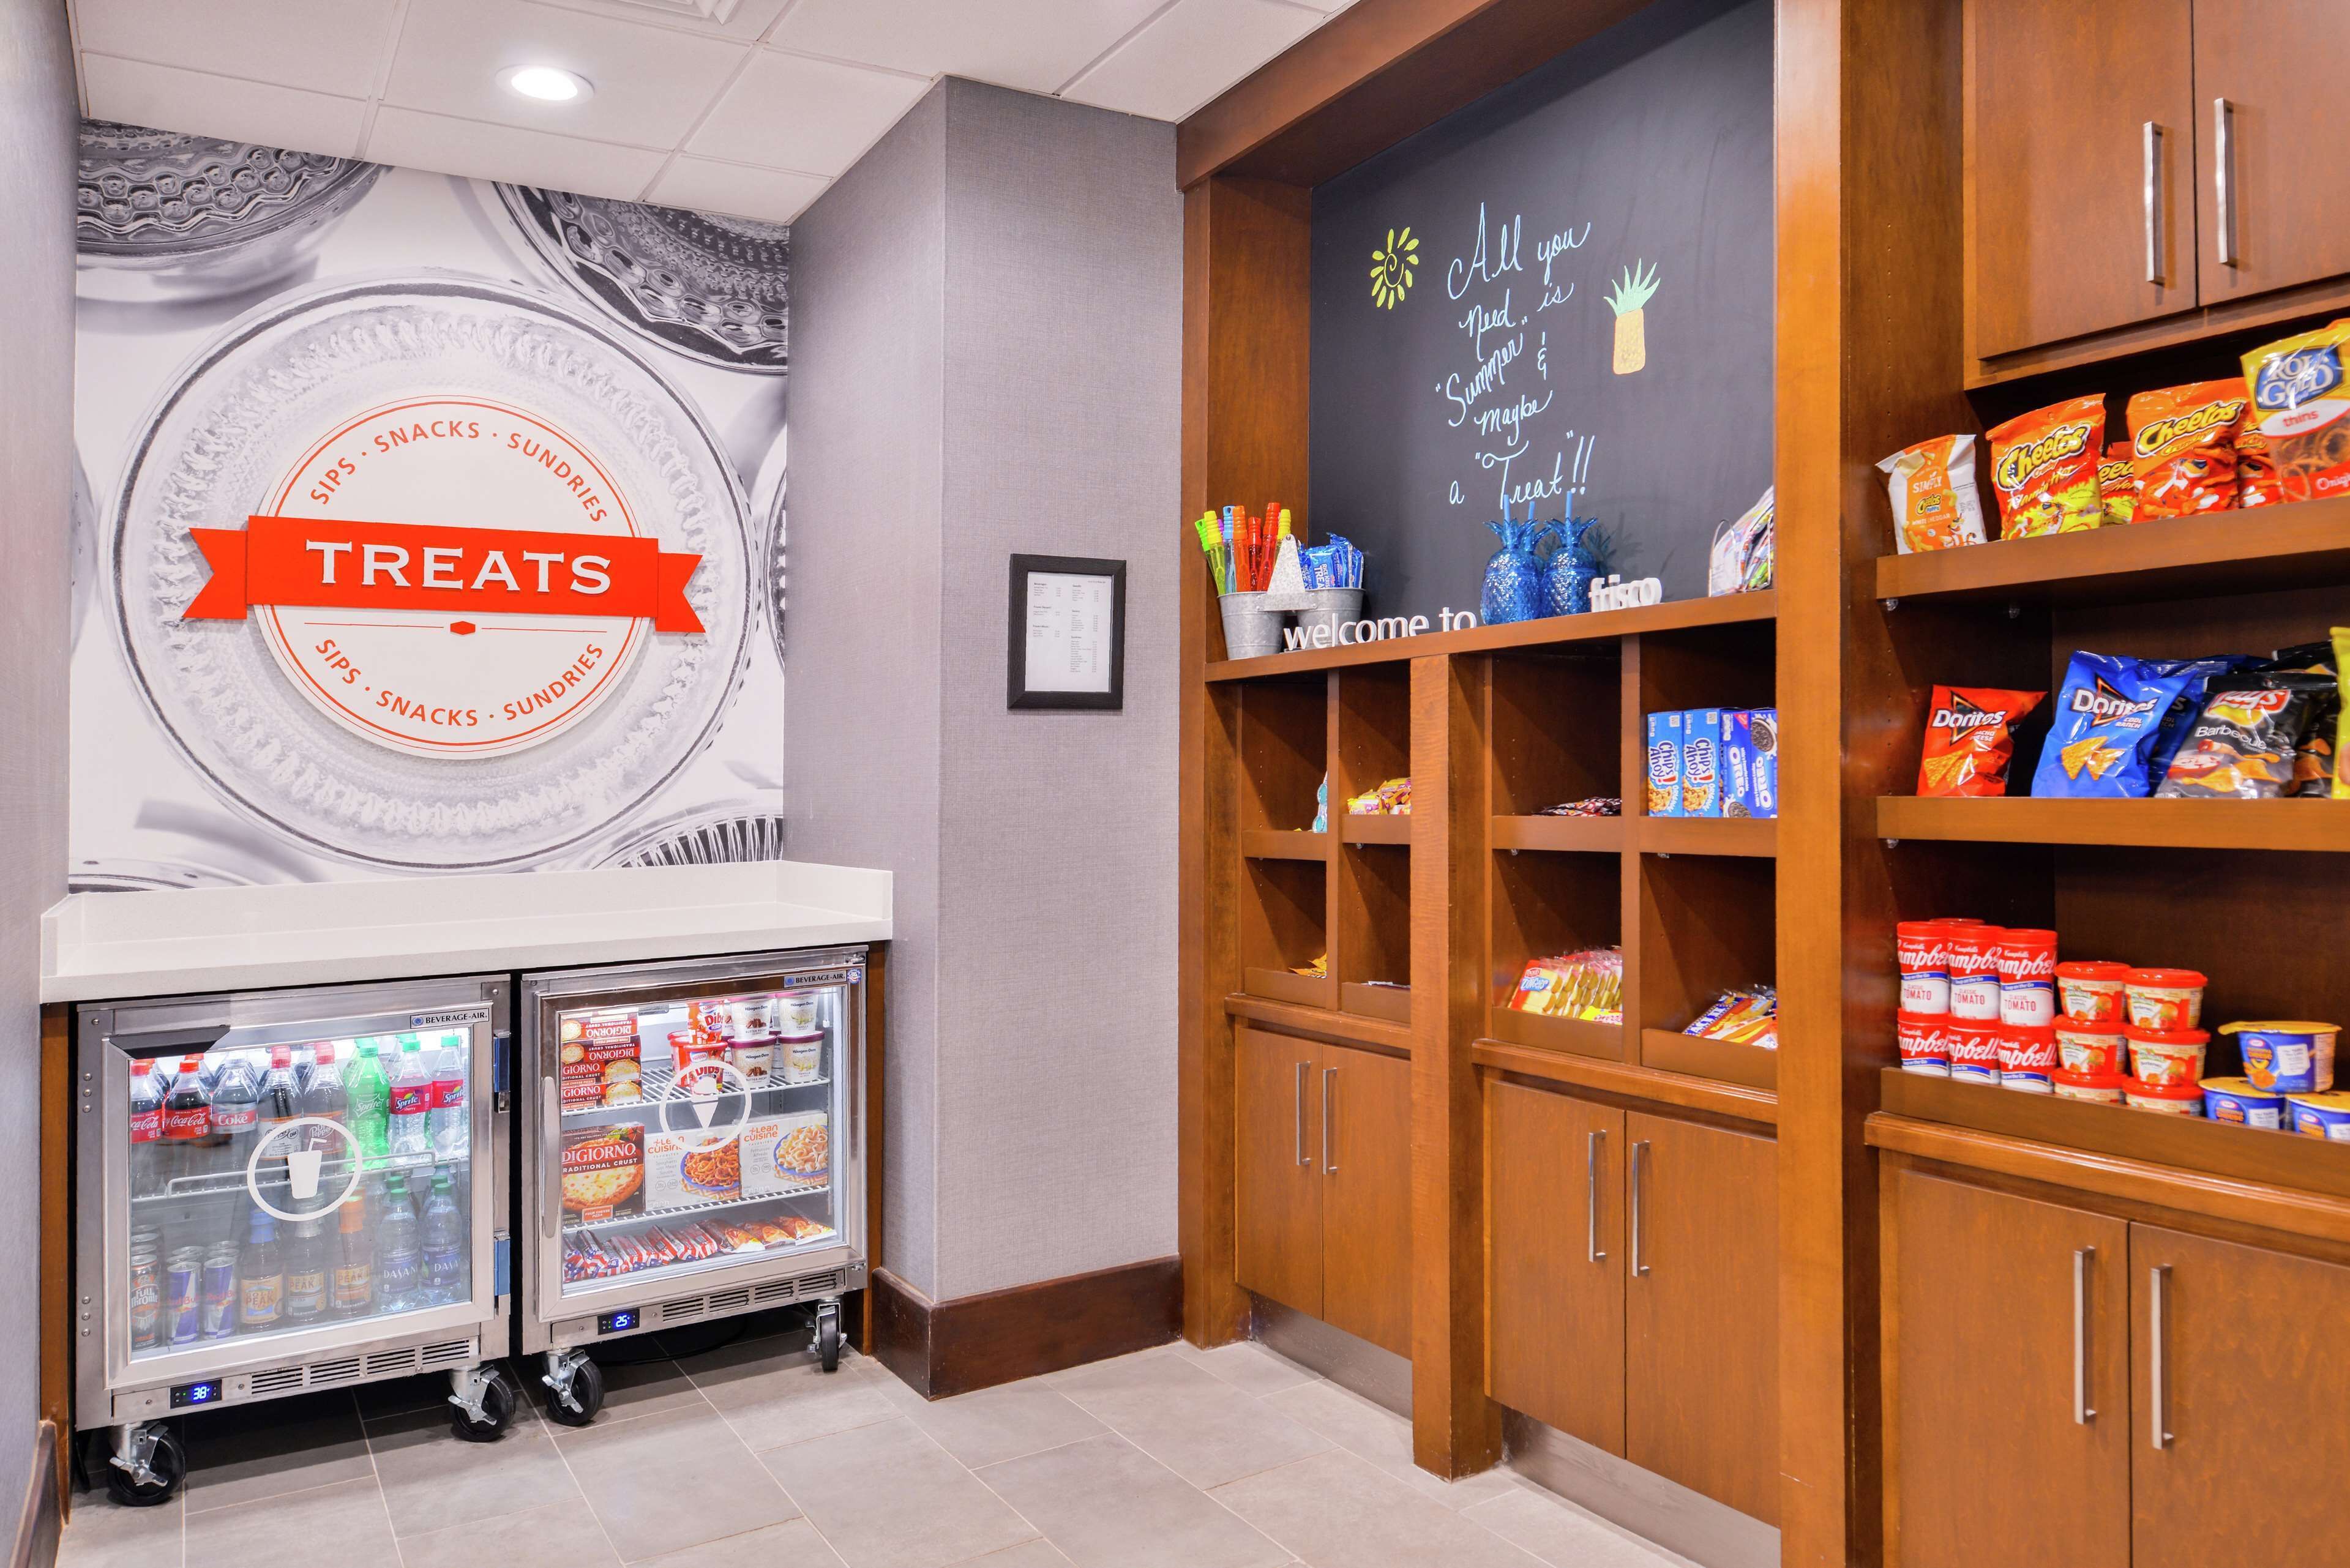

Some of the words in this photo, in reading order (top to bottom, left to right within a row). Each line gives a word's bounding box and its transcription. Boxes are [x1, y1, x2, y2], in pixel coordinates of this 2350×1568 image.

[1448, 202, 1523, 300] All
[1537, 222, 1590, 285] you
[1537, 283, 1574, 311] is
[2283, 410, 2319, 427] thins
[2137, 401, 2244, 456] Cheetos
[1999, 427, 2088, 489] Cheetos
[310, 457, 356, 505] SIPS
[373, 420, 481, 453] SNACKS
[507, 431, 608, 525] SUNDRIES
[1450, 480, 1464, 504] a
[305, 539, 612, 594] TREATS
[1283, 612, 1429, 652] welcome
[1439, 607, 1478, 632] to
[1589, 574, 1663, 613] frisco
[315, 638, 362, 686] SIPS
[375, 689, 479, 728] SNACKS
[503, 643, 604, 722] SUNDRIES
[2072, 689, 2160, 715] Doritos
[1932, 709, 2008, 728] Doritos
[2194, 726, 2267, 750] Barbecue
[1658, 741, 1675, 776] Chips
[1695, 738, 1712, 776] Chips
[1729, 746, 1745, 797] OREO
[1756, 756, 1773, 809] OREO
[796, 974, 844, 984] BEVERAGE-AIR
[1904, 990, 1932, 1000] TOMATO
[1955, 993, 1985, 1005] TOMATO
[2004, 999, 2037, 1011] TOMATO
[425, 1012, 485, 1024] BEVERAGE-AIR
[563, 1063, 600, 1075] GIORNO
[357, 1100, 382, 1111] Sprite
[395, 1096, 418, 1110] Sprite
[170, 1112, 206, 1127] Coca-Cola
[218, 1113, 248, 1126] Coke
[756, 1124, 778, 1133] Lean
[563, 1162, 611, 1173] RADITIONAL
[289, 1281, 315, 1290] PEAK
[337, 1273, 364, 1283] PEAK
[245, 1294, 275, 1306] PEAK
